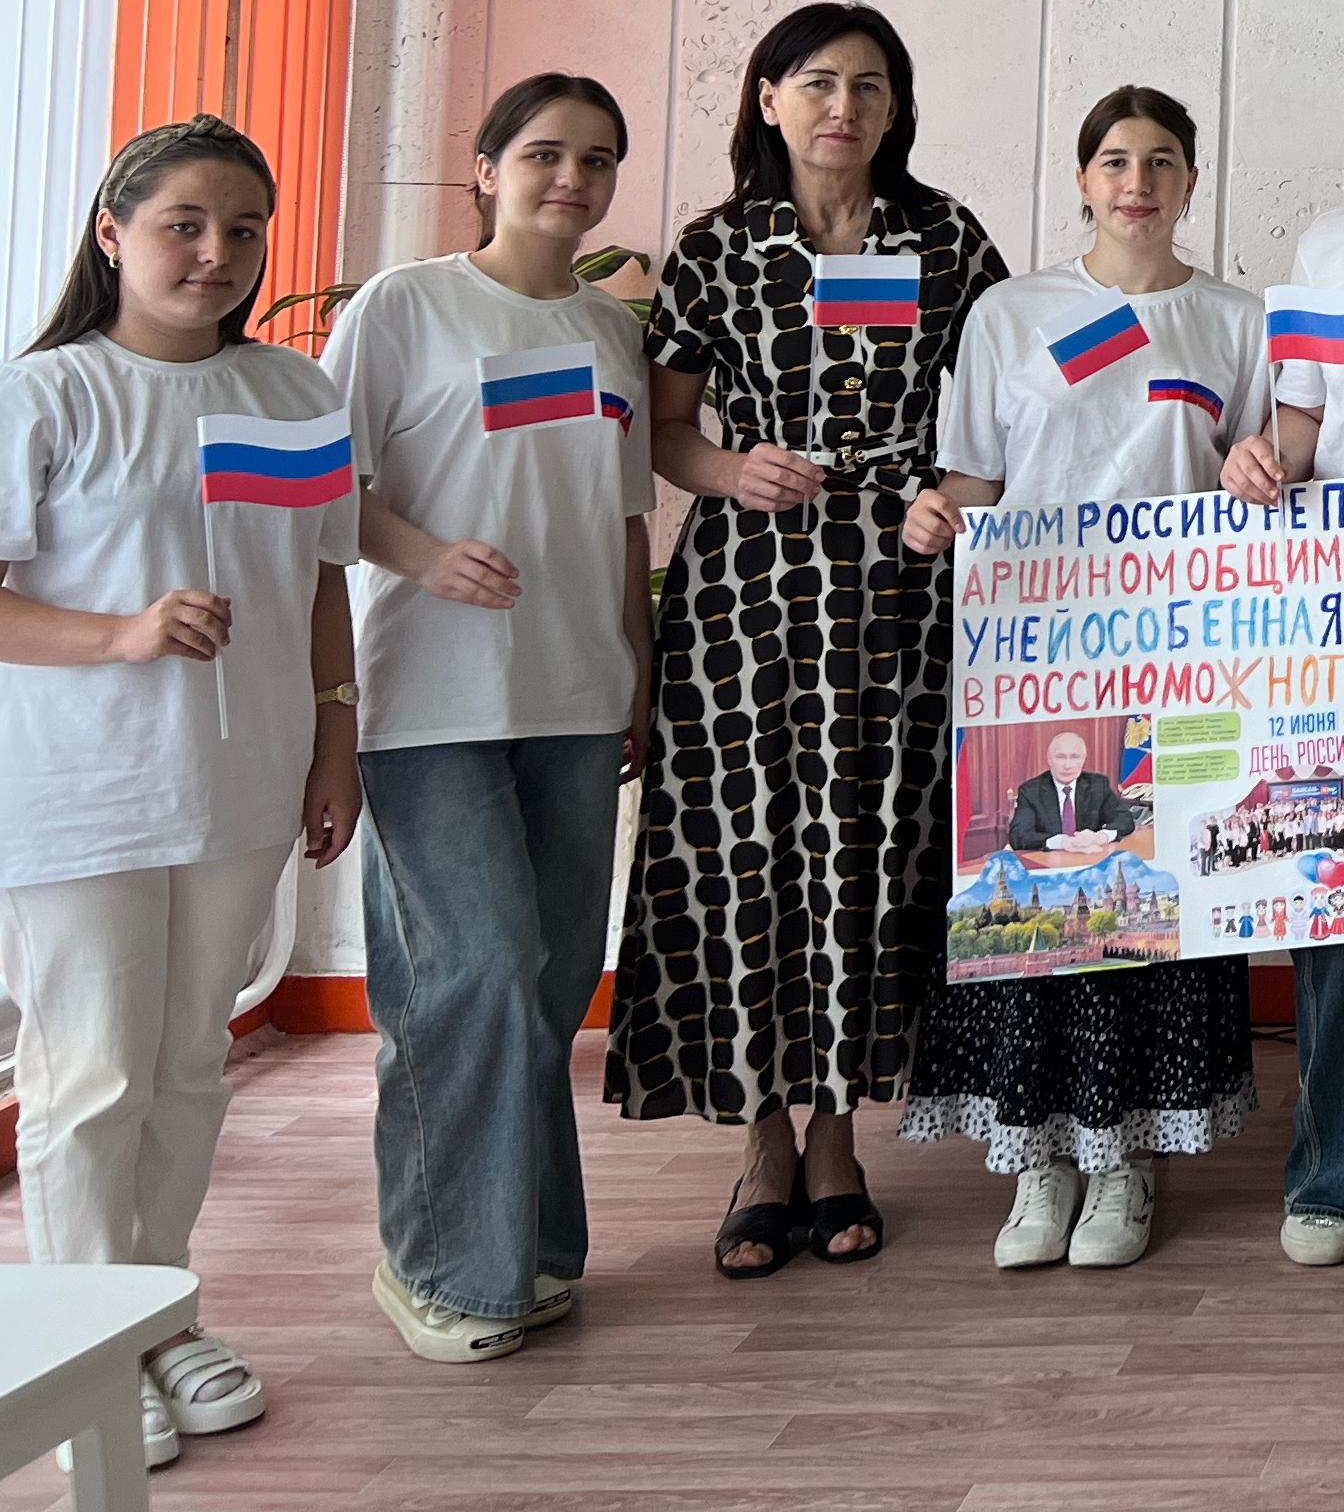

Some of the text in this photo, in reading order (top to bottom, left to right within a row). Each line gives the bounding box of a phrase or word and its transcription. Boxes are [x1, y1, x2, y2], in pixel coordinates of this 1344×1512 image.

[966, 506, 1063, 551] УМОМ
[1077, 494, 1249, 547] РОССИЮ
[1268, 711, 1337, 737] 12 ИЮНЯ
[1249, 745, 1290, 776] ДЕНЬ
